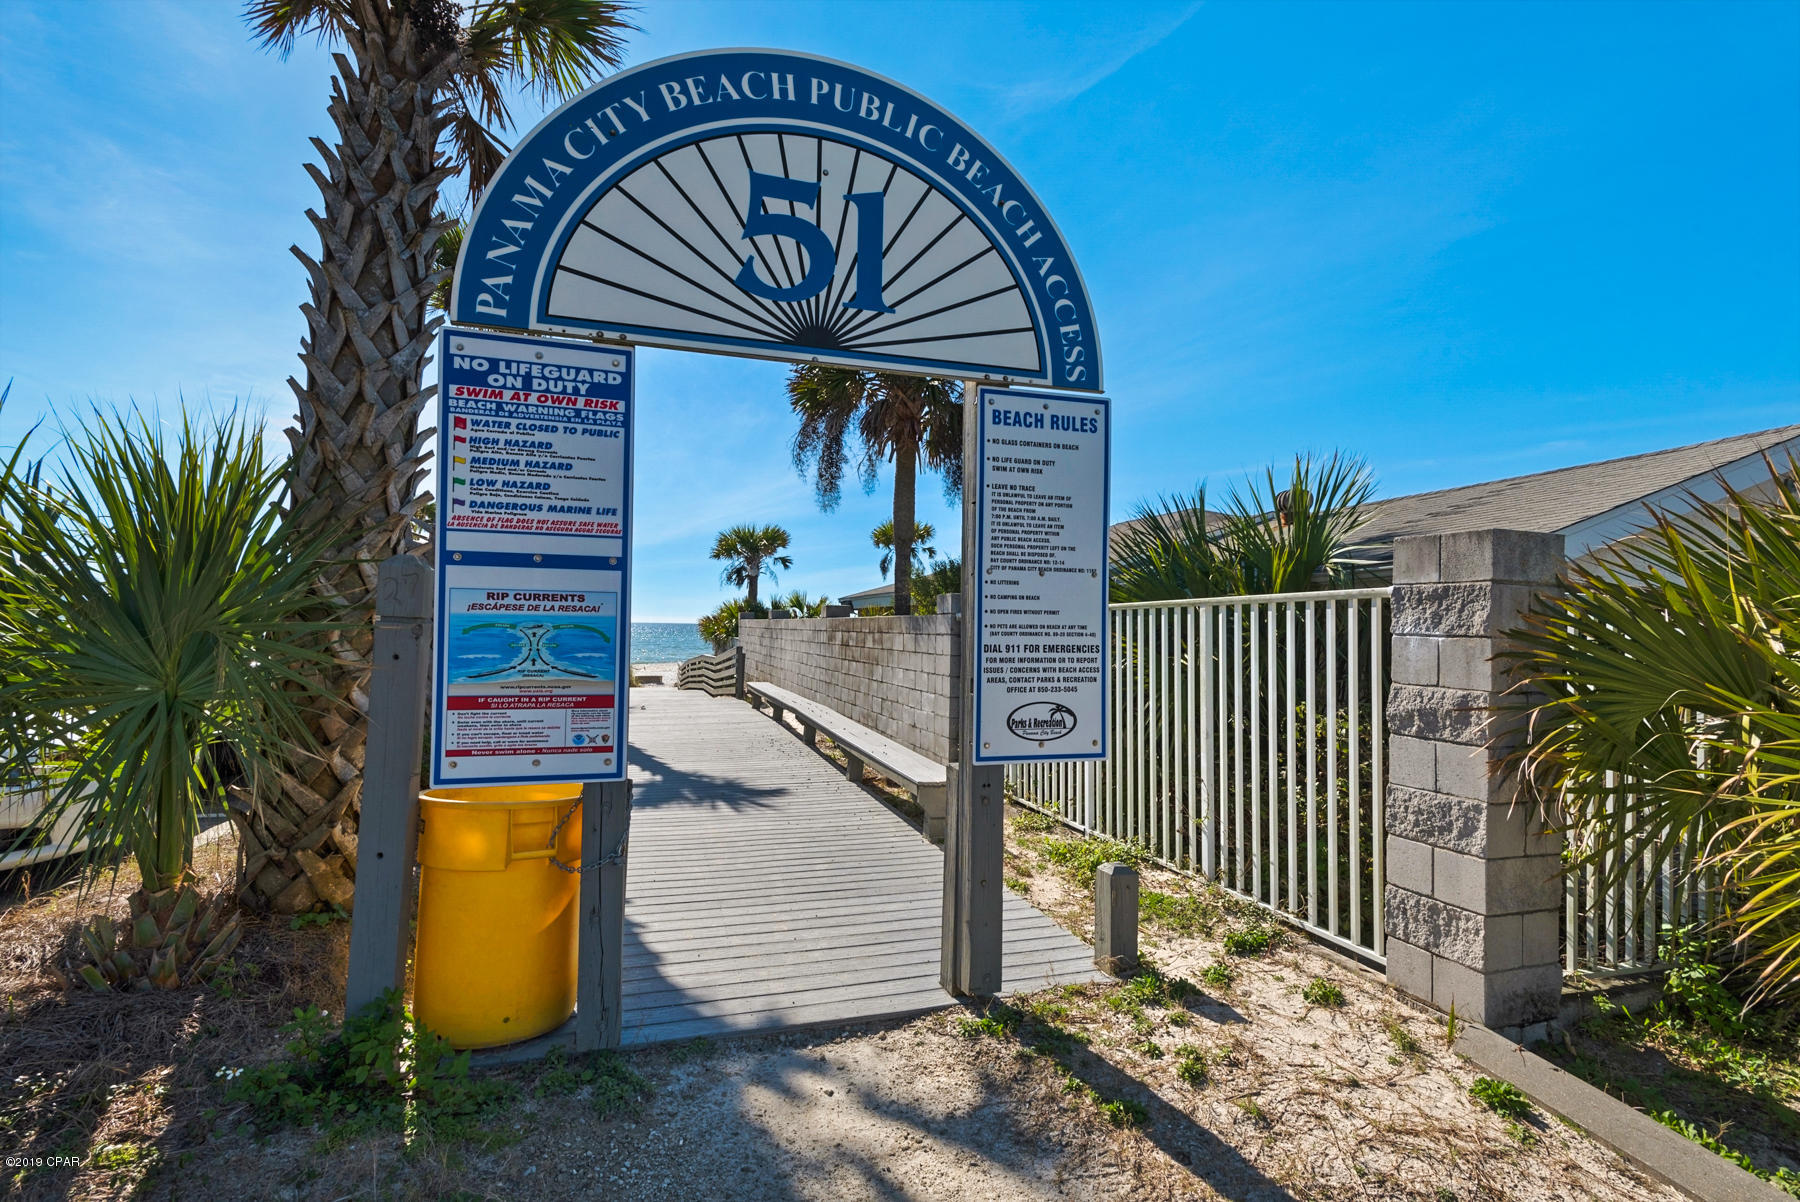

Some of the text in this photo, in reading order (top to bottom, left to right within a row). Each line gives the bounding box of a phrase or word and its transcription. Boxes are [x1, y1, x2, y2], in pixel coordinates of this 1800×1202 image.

[475, 71, 1087, 382] PANAMA CITY BEACH PUBLIC BEACH ACCESS
[733, 168, 896, 314] 51
[453, 356, 622, 385] NO LIFEGUARD
[487, 374, 591, 395] ON DUTY
[454, 386, 620, 411] SWIM AT OWN RISK
[448, 398, 624, 422] BEACH WARNING FLAGS
[450, 407, 496, 415] BANDERAS
[470, 419, 620, 438] WATER CLOSED TO PUBLIC
[992, 409, 1098, 434] BEACH RULES
[469, 436, 553, 450] HIGH HAZARD
[1019, 440, 1052, 448] CONTAINERS
[470, 456, 573, 471] MEDIUM HAZARD
[469, 478, 551, 491] LOW HAZARD
[469, 500, 618, 516] DANGEROUS MARINE LIFE
[452, 515, 484, 523] ABSENCE
[486, 592, 586, 602] RIP CURRENTS
[984, 644, 1100, 654] DIAL 911 FOR EMERGENCIES
[1012, 718, 1063, 728] Parks & Recreation
